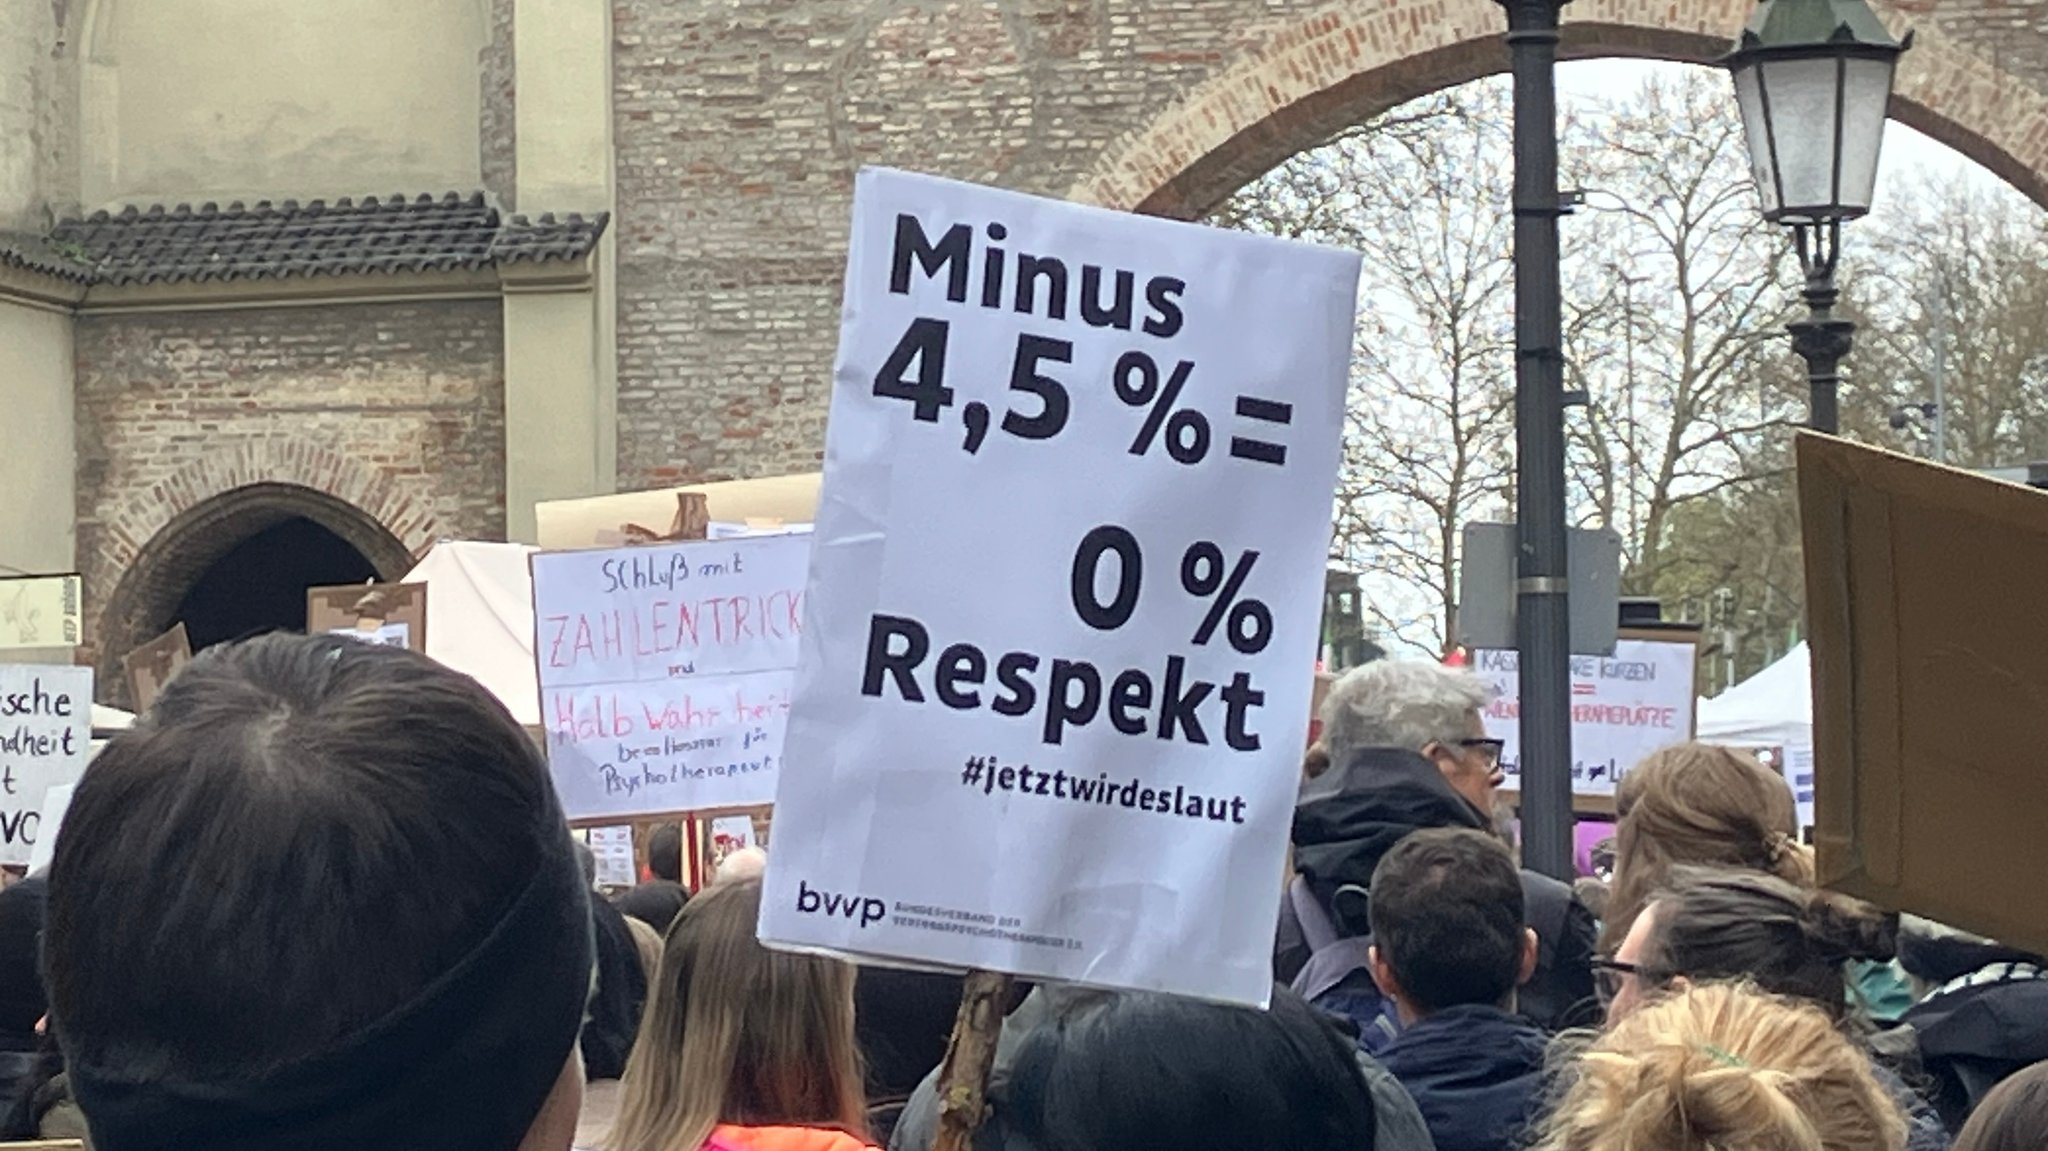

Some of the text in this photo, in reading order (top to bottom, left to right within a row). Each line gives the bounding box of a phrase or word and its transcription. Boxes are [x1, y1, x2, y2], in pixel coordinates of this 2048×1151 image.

[889, 213, 1187, 338] Minus
[872, 316, 1074, 456] 4,5
[1070, 524, 1274, 655] 0 %
[0, 678, 71, 716] sche
[861, 612, 1265, 752] Respekt
[962, 755, 1248, 824] #jetztwirdeslaut
[796, 879, 886, 929] bvvp
